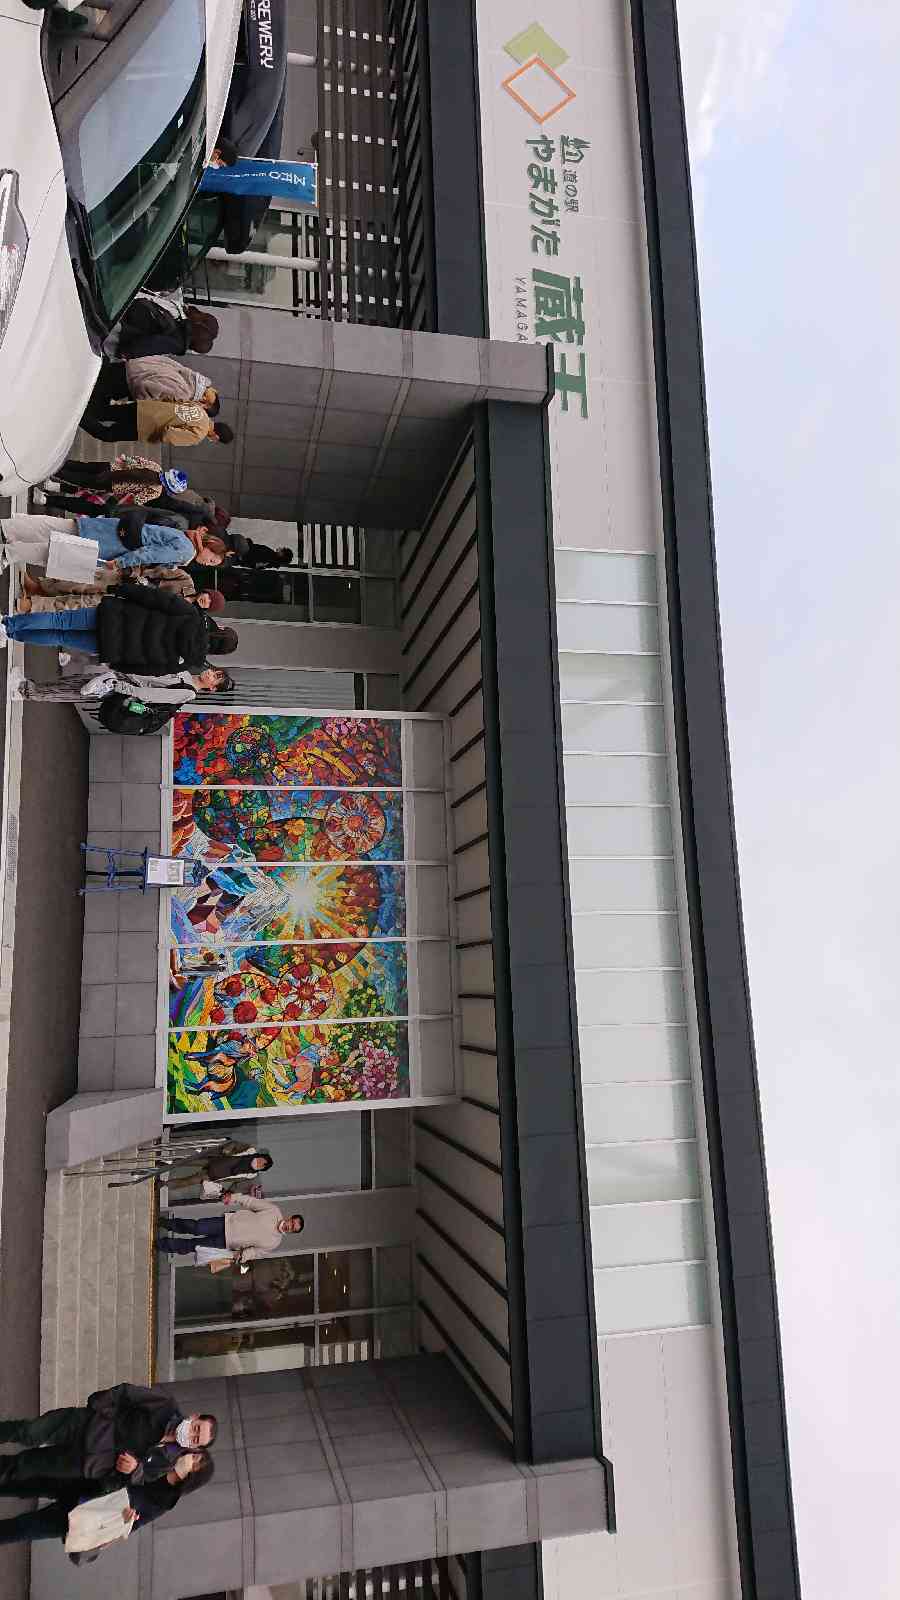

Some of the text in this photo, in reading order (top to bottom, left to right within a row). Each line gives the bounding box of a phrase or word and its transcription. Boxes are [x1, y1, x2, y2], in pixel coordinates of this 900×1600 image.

[526, 135, 561, 256] やまがた
[563, 169, 579, 213] 道の駅
[532, 268, 589, 419] 蔵王
